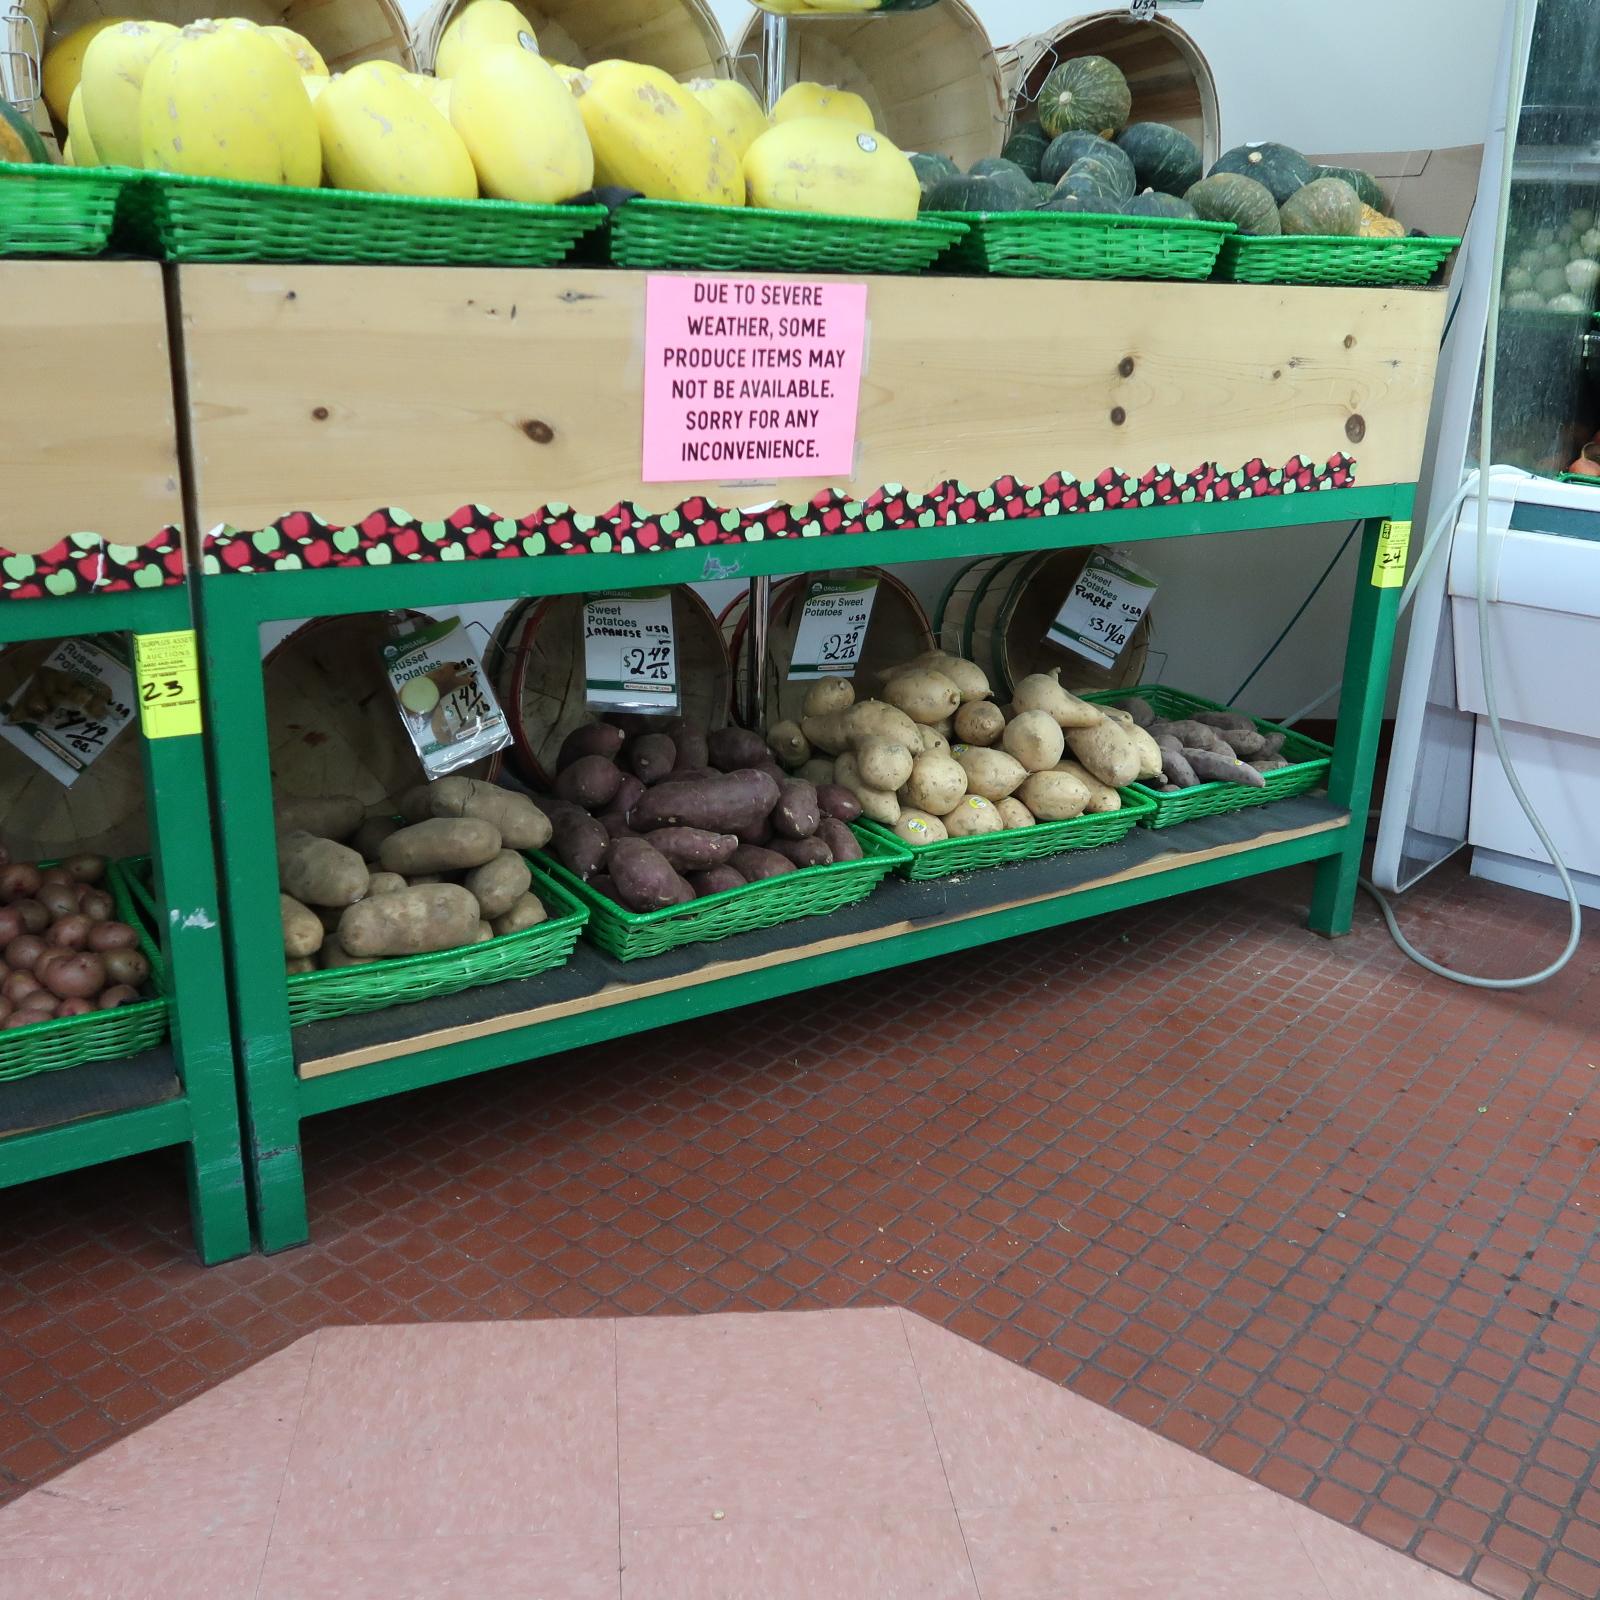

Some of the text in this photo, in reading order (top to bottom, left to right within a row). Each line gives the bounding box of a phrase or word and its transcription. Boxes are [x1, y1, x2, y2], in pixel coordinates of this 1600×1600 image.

[1133, 0, 1157, 9] USA
[693, 283, 823, 306] DUE TO SEVERE
[687, 315, 826, 340] WEATHER, SOME
[663, 348, 846, 368] PRODUCE ITEMS MAY
[672, 379, 834, 399] NOT BE AVAILABLE.
[686, 409, 819, 430] SORRY FOR ANY
[681, 439, 820, 462] INCONVENIENCE.
[1383, 549, 1401, 564] 24
[1085, 568, 1112, 587] Sweet
[1075, 585, 1113, 610] PURPLE
[1081, 577, 1118, 601] Potatoes
[587, 604, 622, 616] Sweet
[805, 608, 842, 616] Potatoes
[806, 598, 864, 608] Jersey Sweet
[1122, 603, 1142, 617] USA
[585, 626, 642, 638] JAPANESE
[588, 616, 637, 628] Potatoes
[645, 625, 669, 634] USA
[65, 643, 104, 676] Russet
[391, 651, 429, 673] Russet
[454, 658, 475, 671] USA
[394, 660, 442, 685] Potatoes
[142, 680, 184, 702] 23
